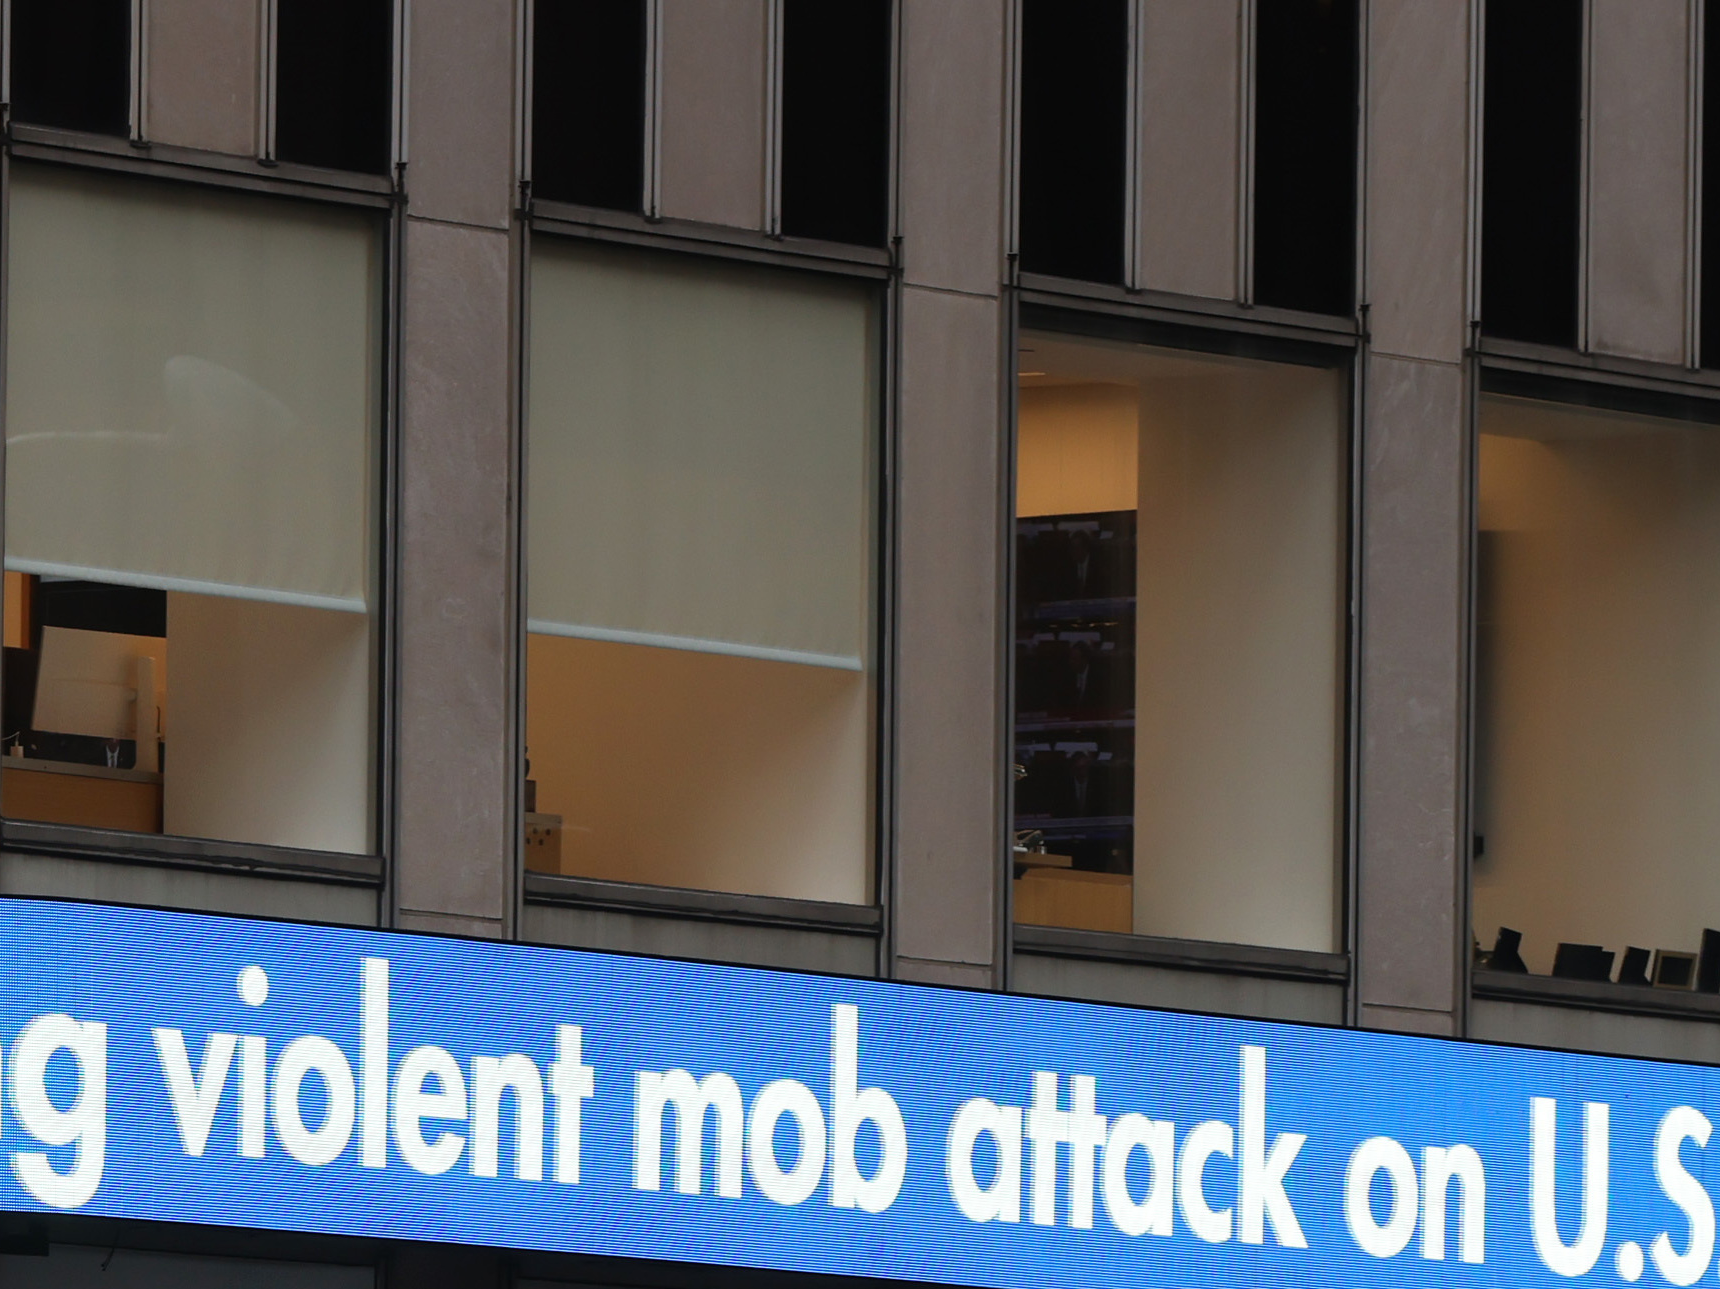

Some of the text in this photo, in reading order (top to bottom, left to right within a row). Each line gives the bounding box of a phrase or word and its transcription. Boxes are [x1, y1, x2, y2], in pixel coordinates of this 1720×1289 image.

[151, 957, 595, 1183] violent
[632, 1005, 908, 1212] mob
[948, 1045, 1308, 1248] attack
[1344, 1135, 1484, 1263] on
